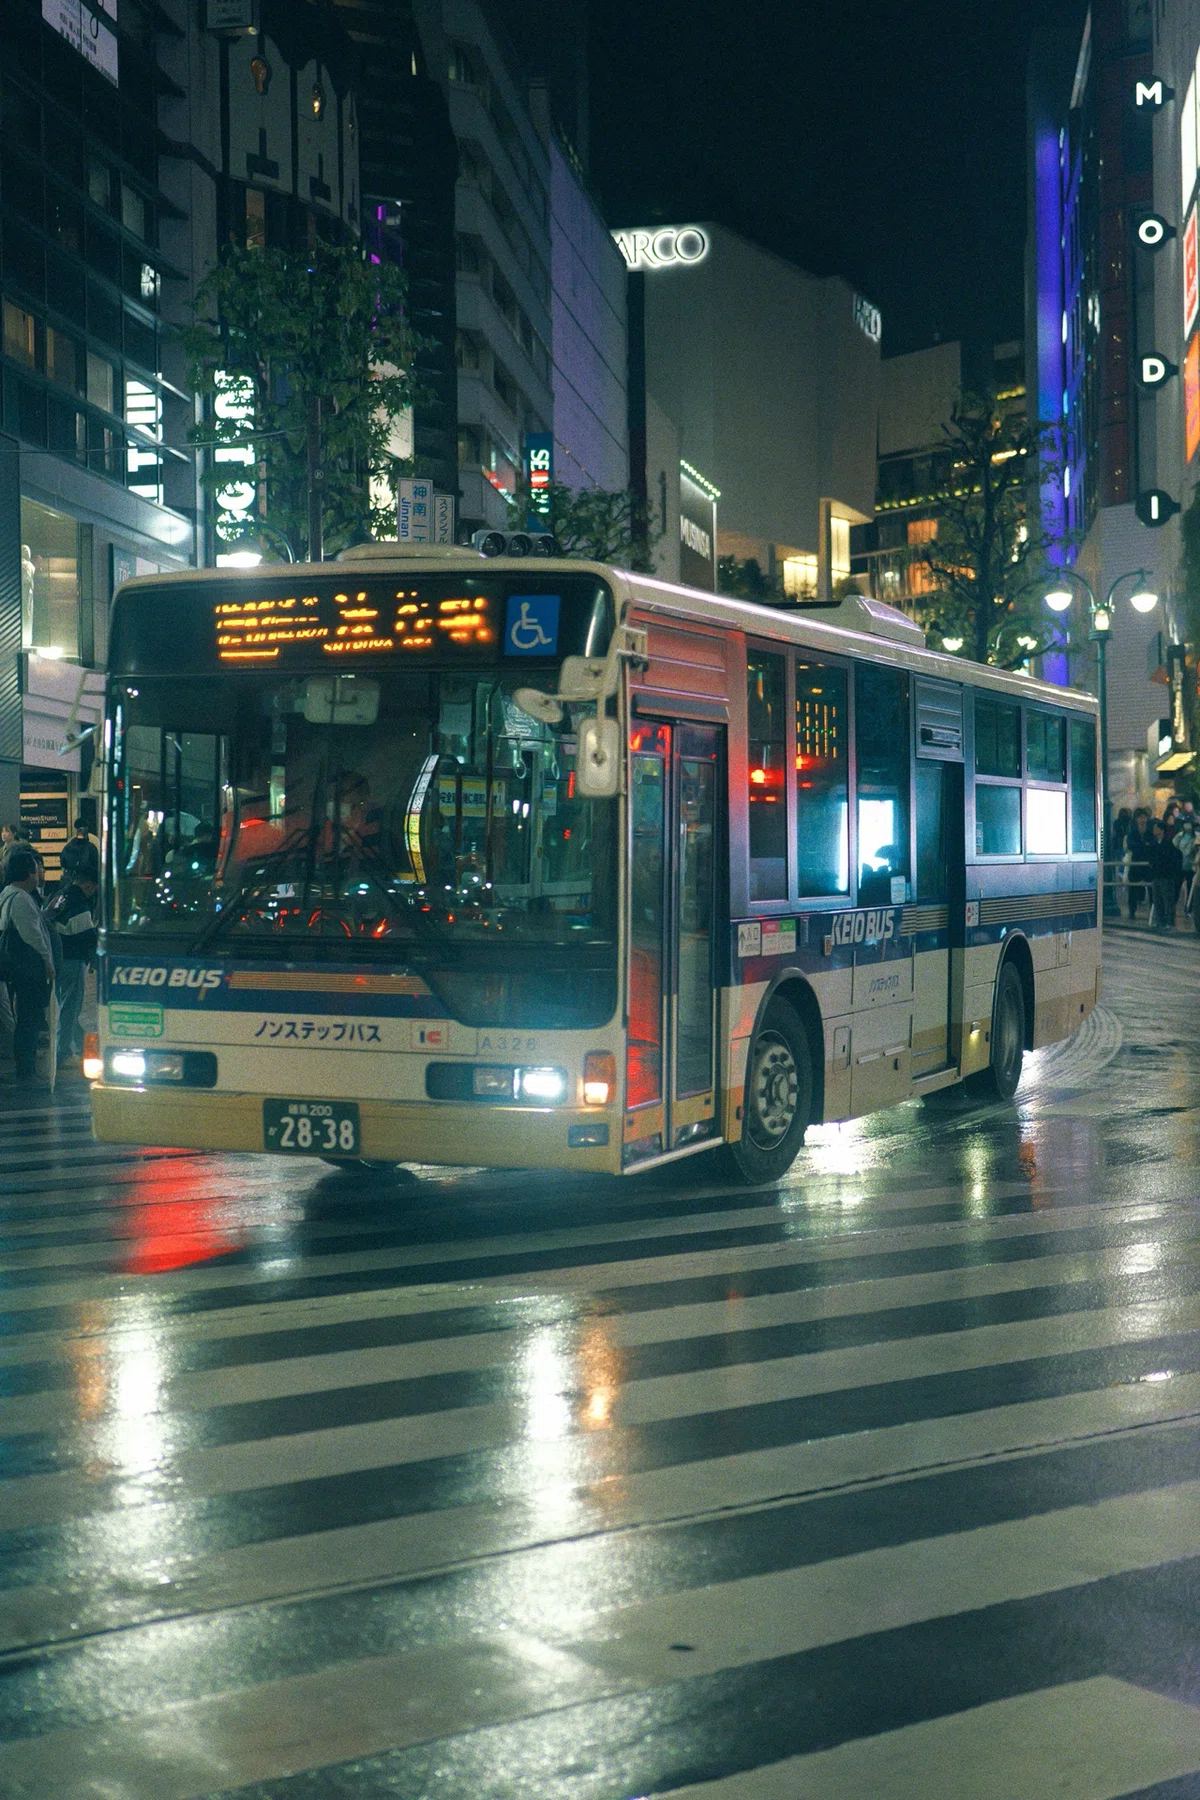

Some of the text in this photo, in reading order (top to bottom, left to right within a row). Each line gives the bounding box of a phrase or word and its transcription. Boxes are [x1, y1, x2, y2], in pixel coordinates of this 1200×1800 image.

[611, 228, 706, 264] ARCO
[1135, 81, 1166, 520] MODI
[401, 498, 411, 537] Jinnan
[831, 912, 864, 946] KEIO
[865, 909, 895, 942] BUS
[111, 966, 223, 988] KEIO BUS
[254, 1020, 382, 1043] ノンステップバス
[280, 1117, 354, 1150] 28-38
